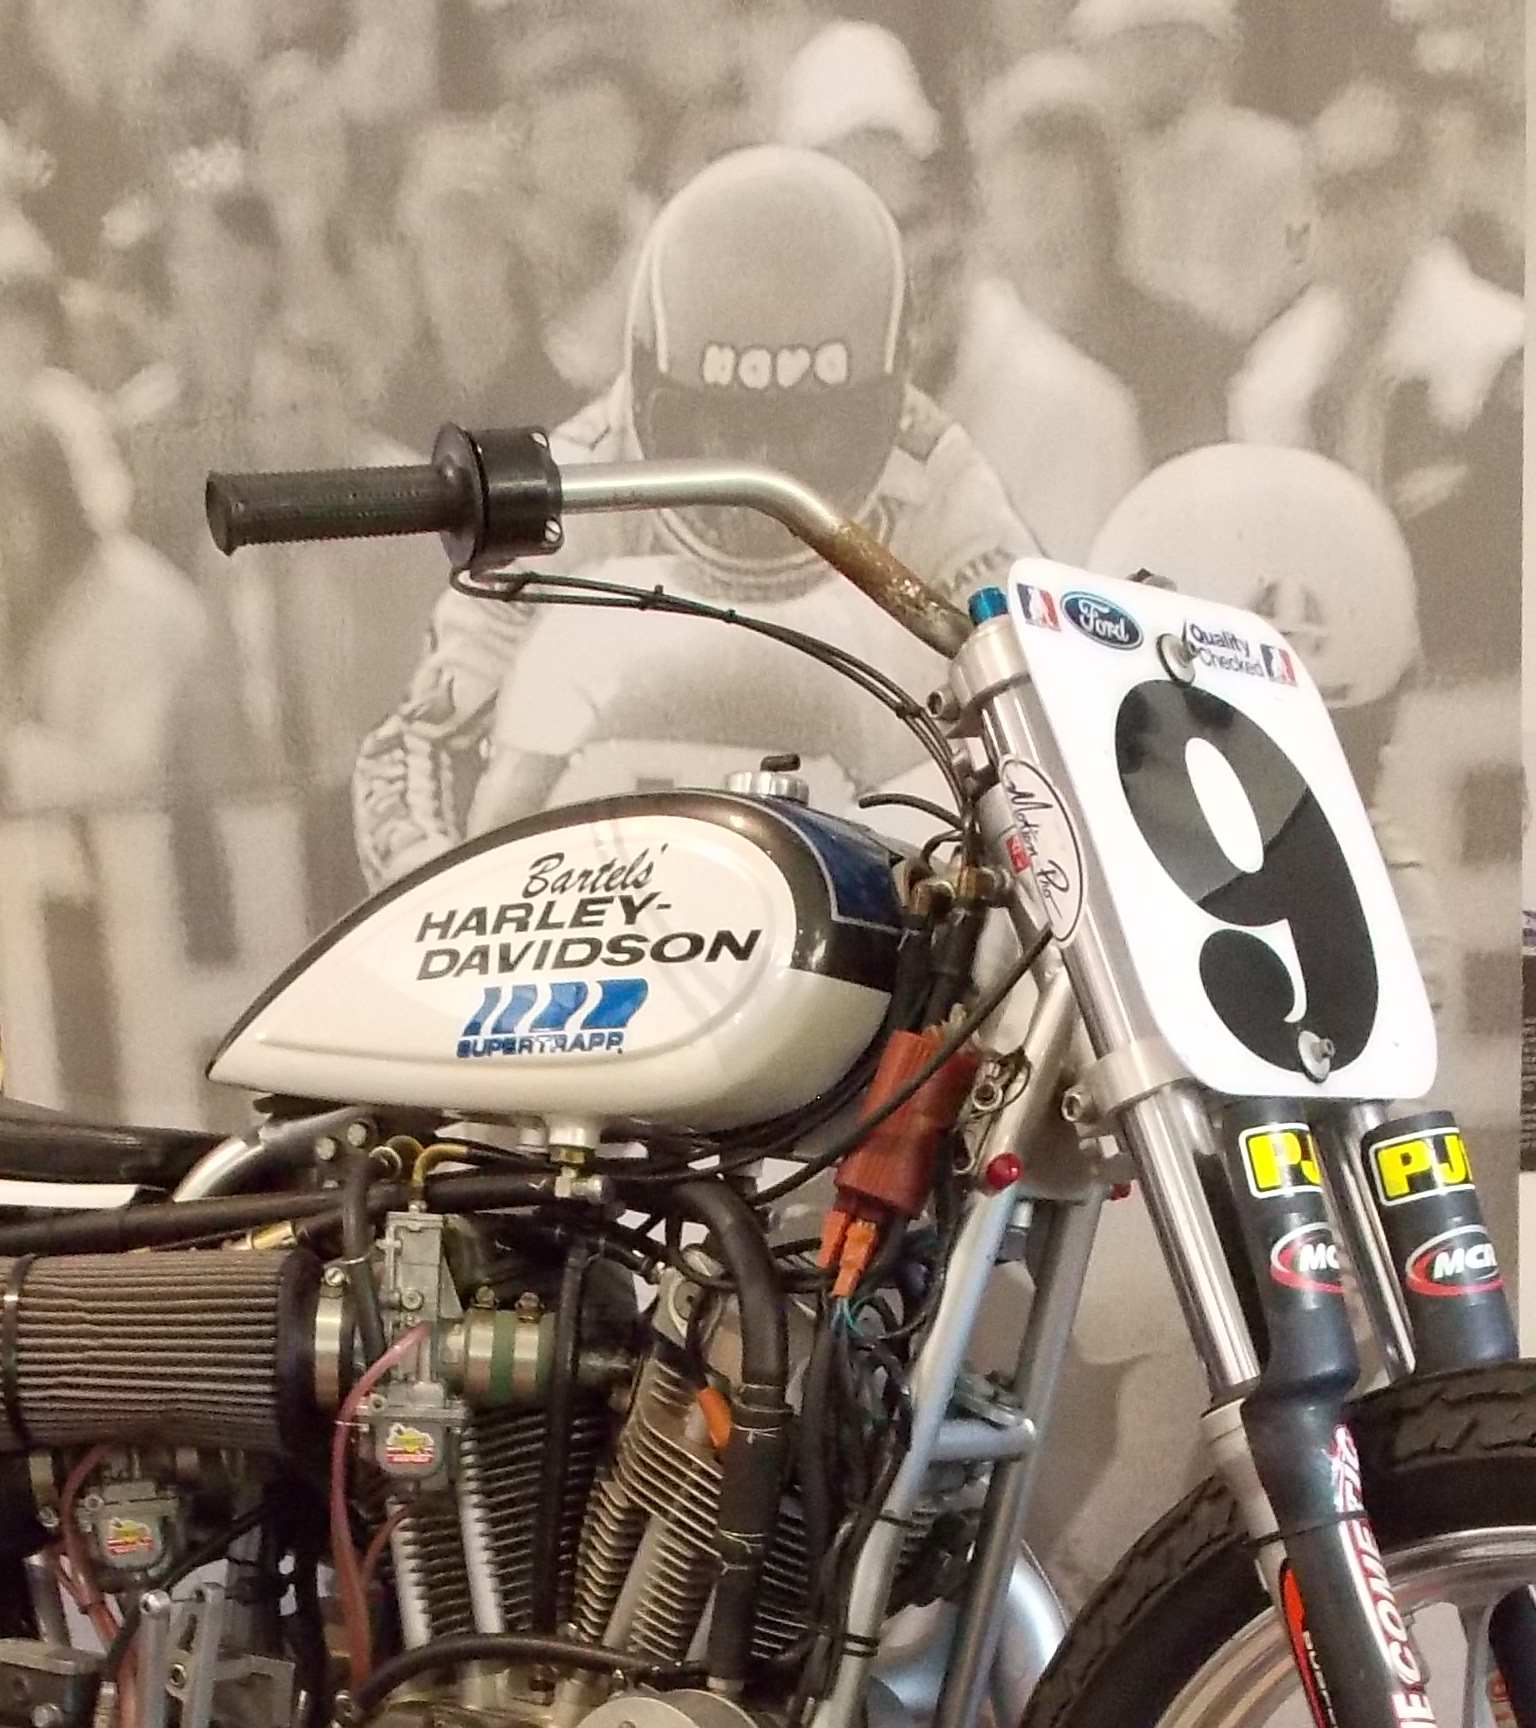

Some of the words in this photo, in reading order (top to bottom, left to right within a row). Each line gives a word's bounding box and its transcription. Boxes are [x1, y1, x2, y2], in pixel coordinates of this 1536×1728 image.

[1077, 600, 1130, 642] Ford
[1189, 622, 1251, 657] Quality
[1199, 643, 1264, 677] Checked
[521, 842, 669, 900] Bartels'
[1115, 679, 1379, 1074] 9
[414, 890, 673, 944] HARLEY-
[415, 928, 763, 981] DAVIDSON
